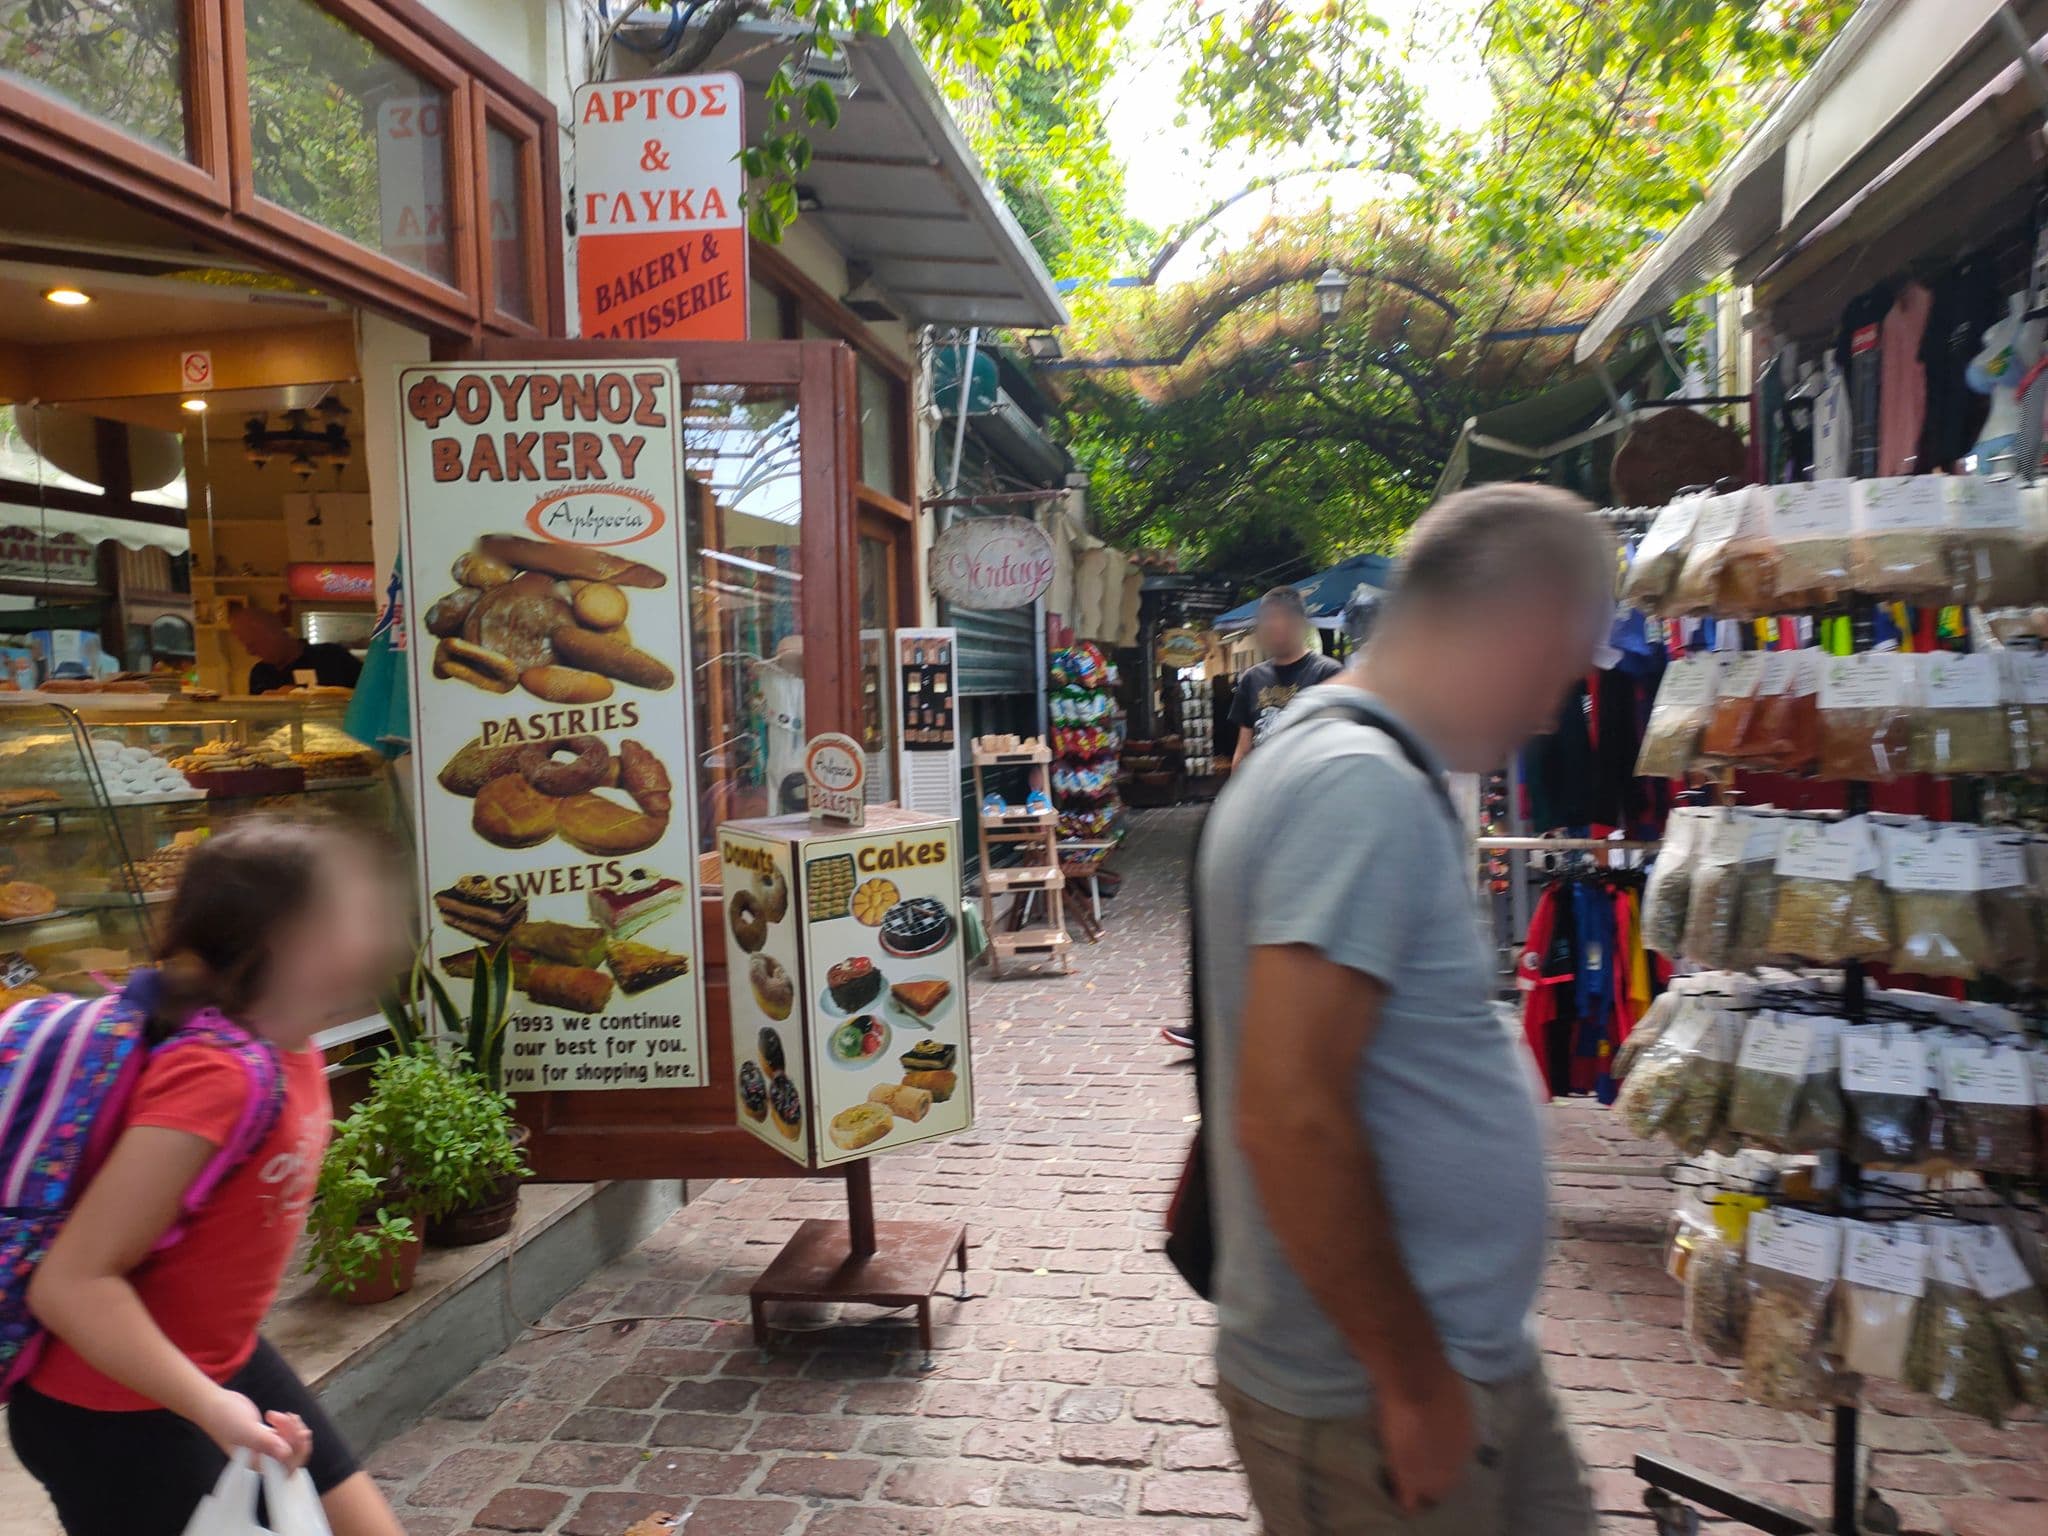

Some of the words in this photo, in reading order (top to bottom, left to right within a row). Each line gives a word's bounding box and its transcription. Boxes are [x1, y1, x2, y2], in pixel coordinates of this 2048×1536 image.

[583, 84, 727, 124] ΑΡΤΟΣ
[639, 139, 671, 172] &
[584, 187, 728, 225] ΓΛΥΚΑ
[594, 242, 693, 315] BAKERY
[700, 233, 720, 263] &
[408, 372, 667, 428] ΦΟΥΡΝΟΣ
[431, 432, 646, 482] BAKERY
[481, 701, 640, 747] PASTRIES
[858, 840, 946, 873] Cakes
[494, 860, 624, 901] SWEETS
[513, 1015, 554, 1032] 1993
[563, 1017, 591, 1031] we
[599, 1012, 681, 1030] continue
[513, 1041, 547, 1057] our
[555, 1038, 598, 1055] best
[606, 1037, 637, 1058] for
[646, 1038, 687, 1057] you.
[504, 1067, 535, 1086] you
[542, 1064, 569, 1085] for
[575, 1062, 649, 1083] shopping
[654, 1061, 695, 1078] here.
